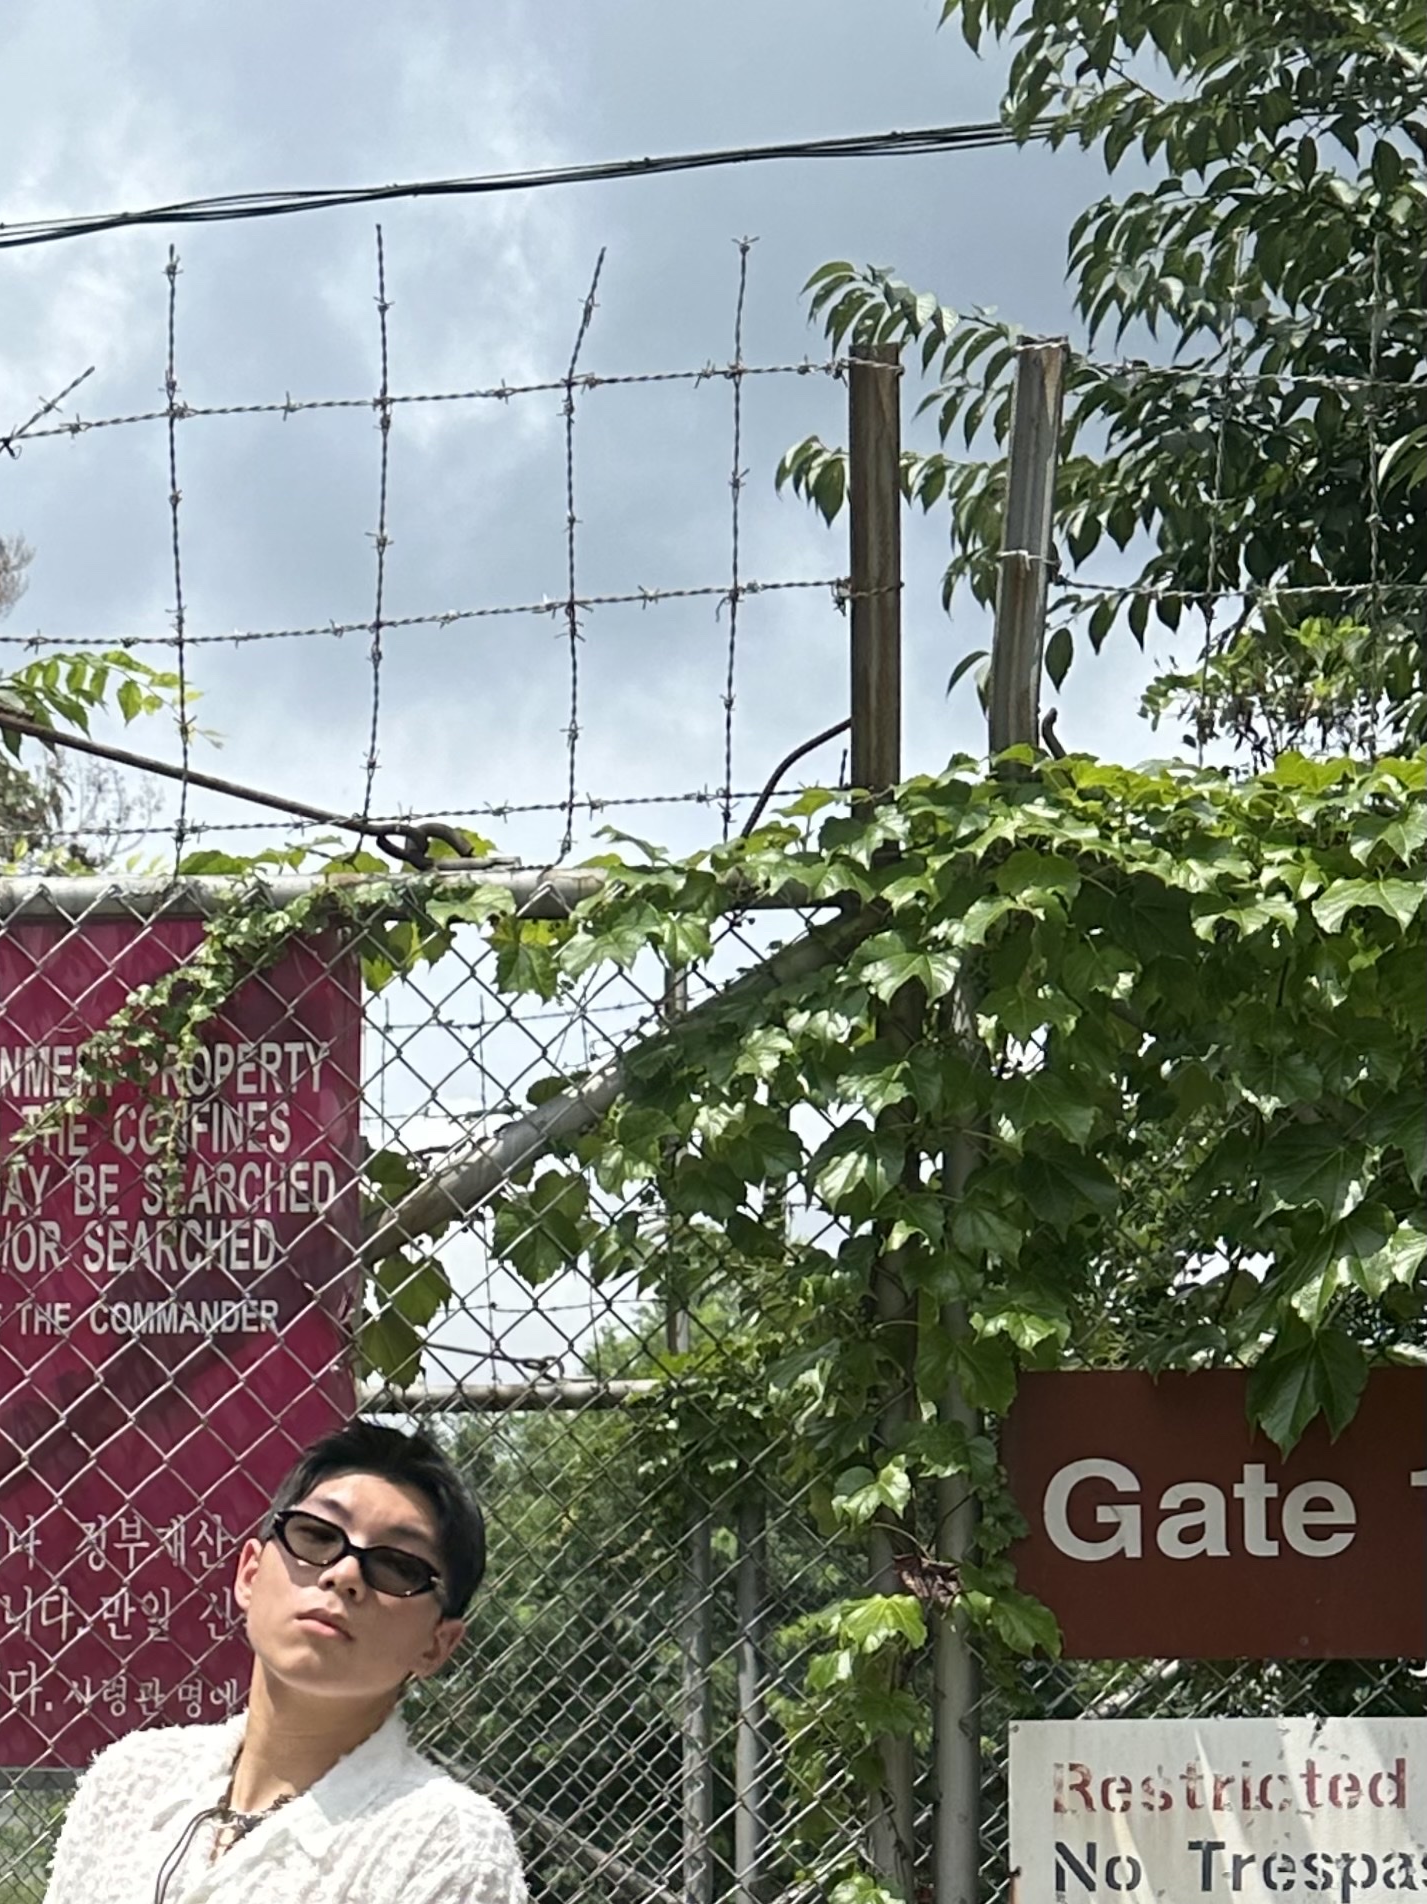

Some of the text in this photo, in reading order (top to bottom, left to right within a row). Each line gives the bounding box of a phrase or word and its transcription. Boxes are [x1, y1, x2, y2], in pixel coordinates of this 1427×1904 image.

[74, 1163, 120, 1216] BE
[142, 1159, 336, 1216] SARCHED
[82, 1218, 276, 1274] SEARCHED
[18, 1302, 71, 1335] THE
[90, 1298, 279, 1334] COMMANDER
[1044, 1458, 1357, 1561] Gate
[1052, 1757, 1407, 1814] Restricted
[1055, 1840, 1427, 1904] No Trespa
